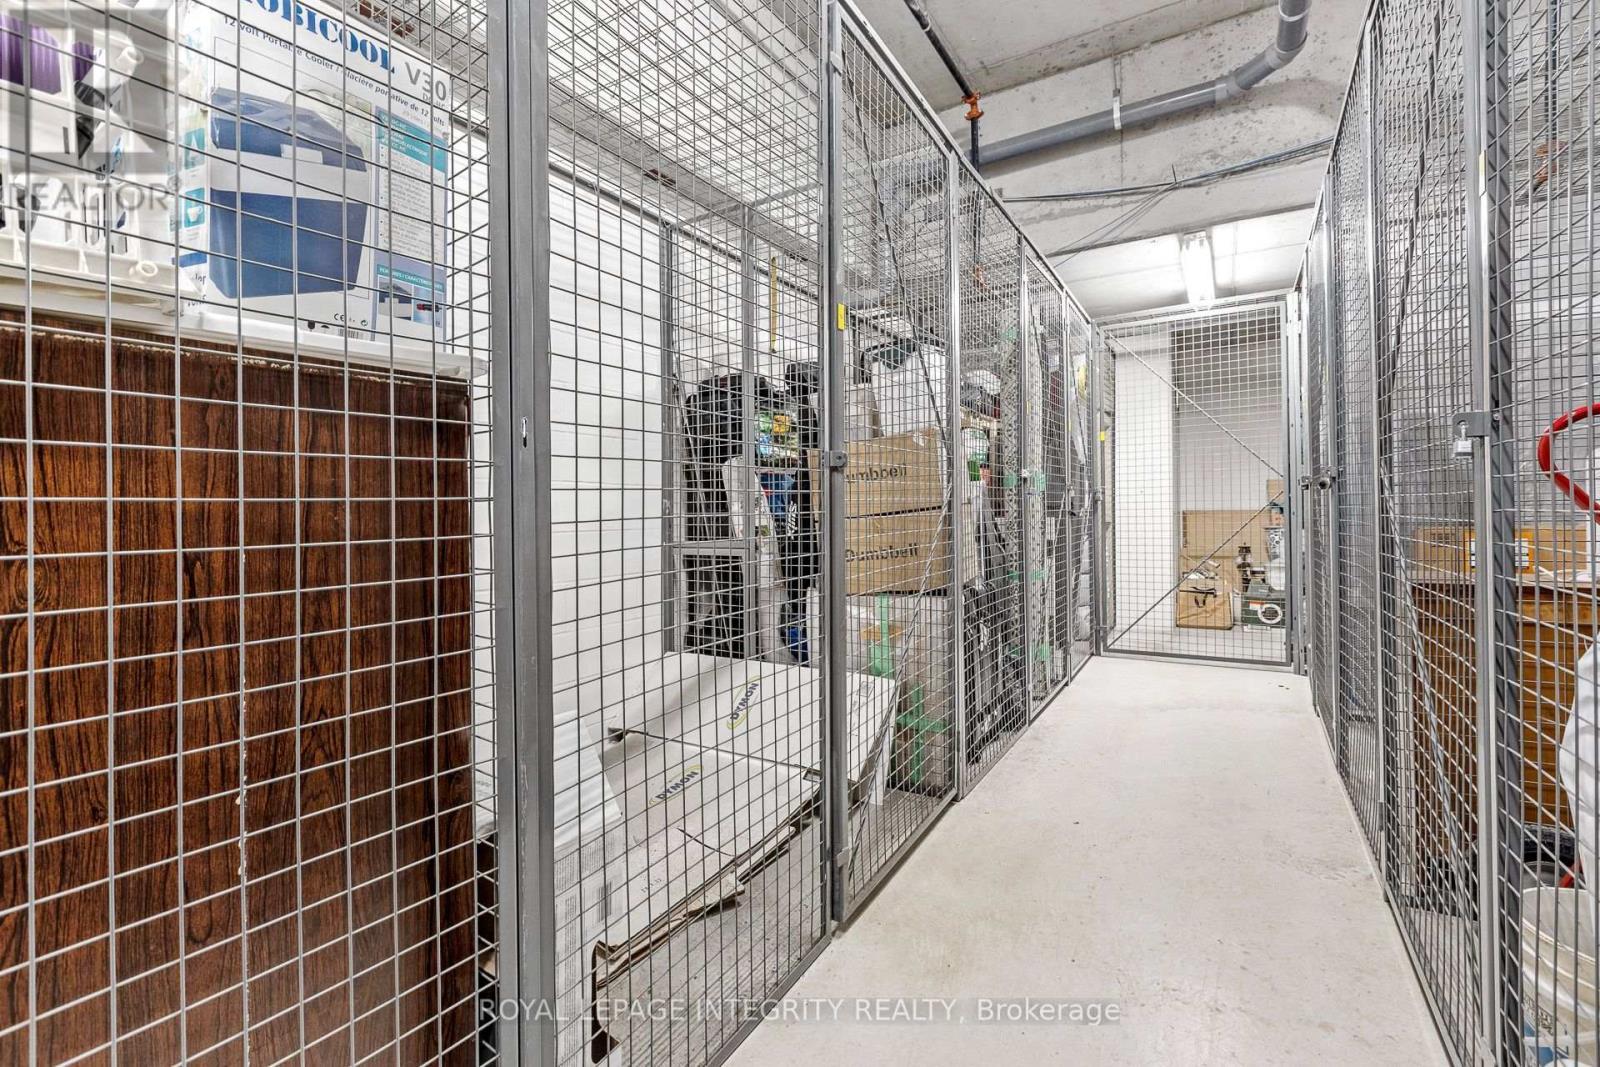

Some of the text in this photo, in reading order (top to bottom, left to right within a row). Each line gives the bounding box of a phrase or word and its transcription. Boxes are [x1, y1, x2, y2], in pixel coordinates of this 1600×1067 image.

[246, 0, 395, 74] OBICOOL
[374, 86, 409, 107] porative
[404, 61, 447, 102] V30
[844, 462, 908, 483] umbbell
[730, 682, 760, 721] DYMON
[655, 770, 699, 800] DYMON
